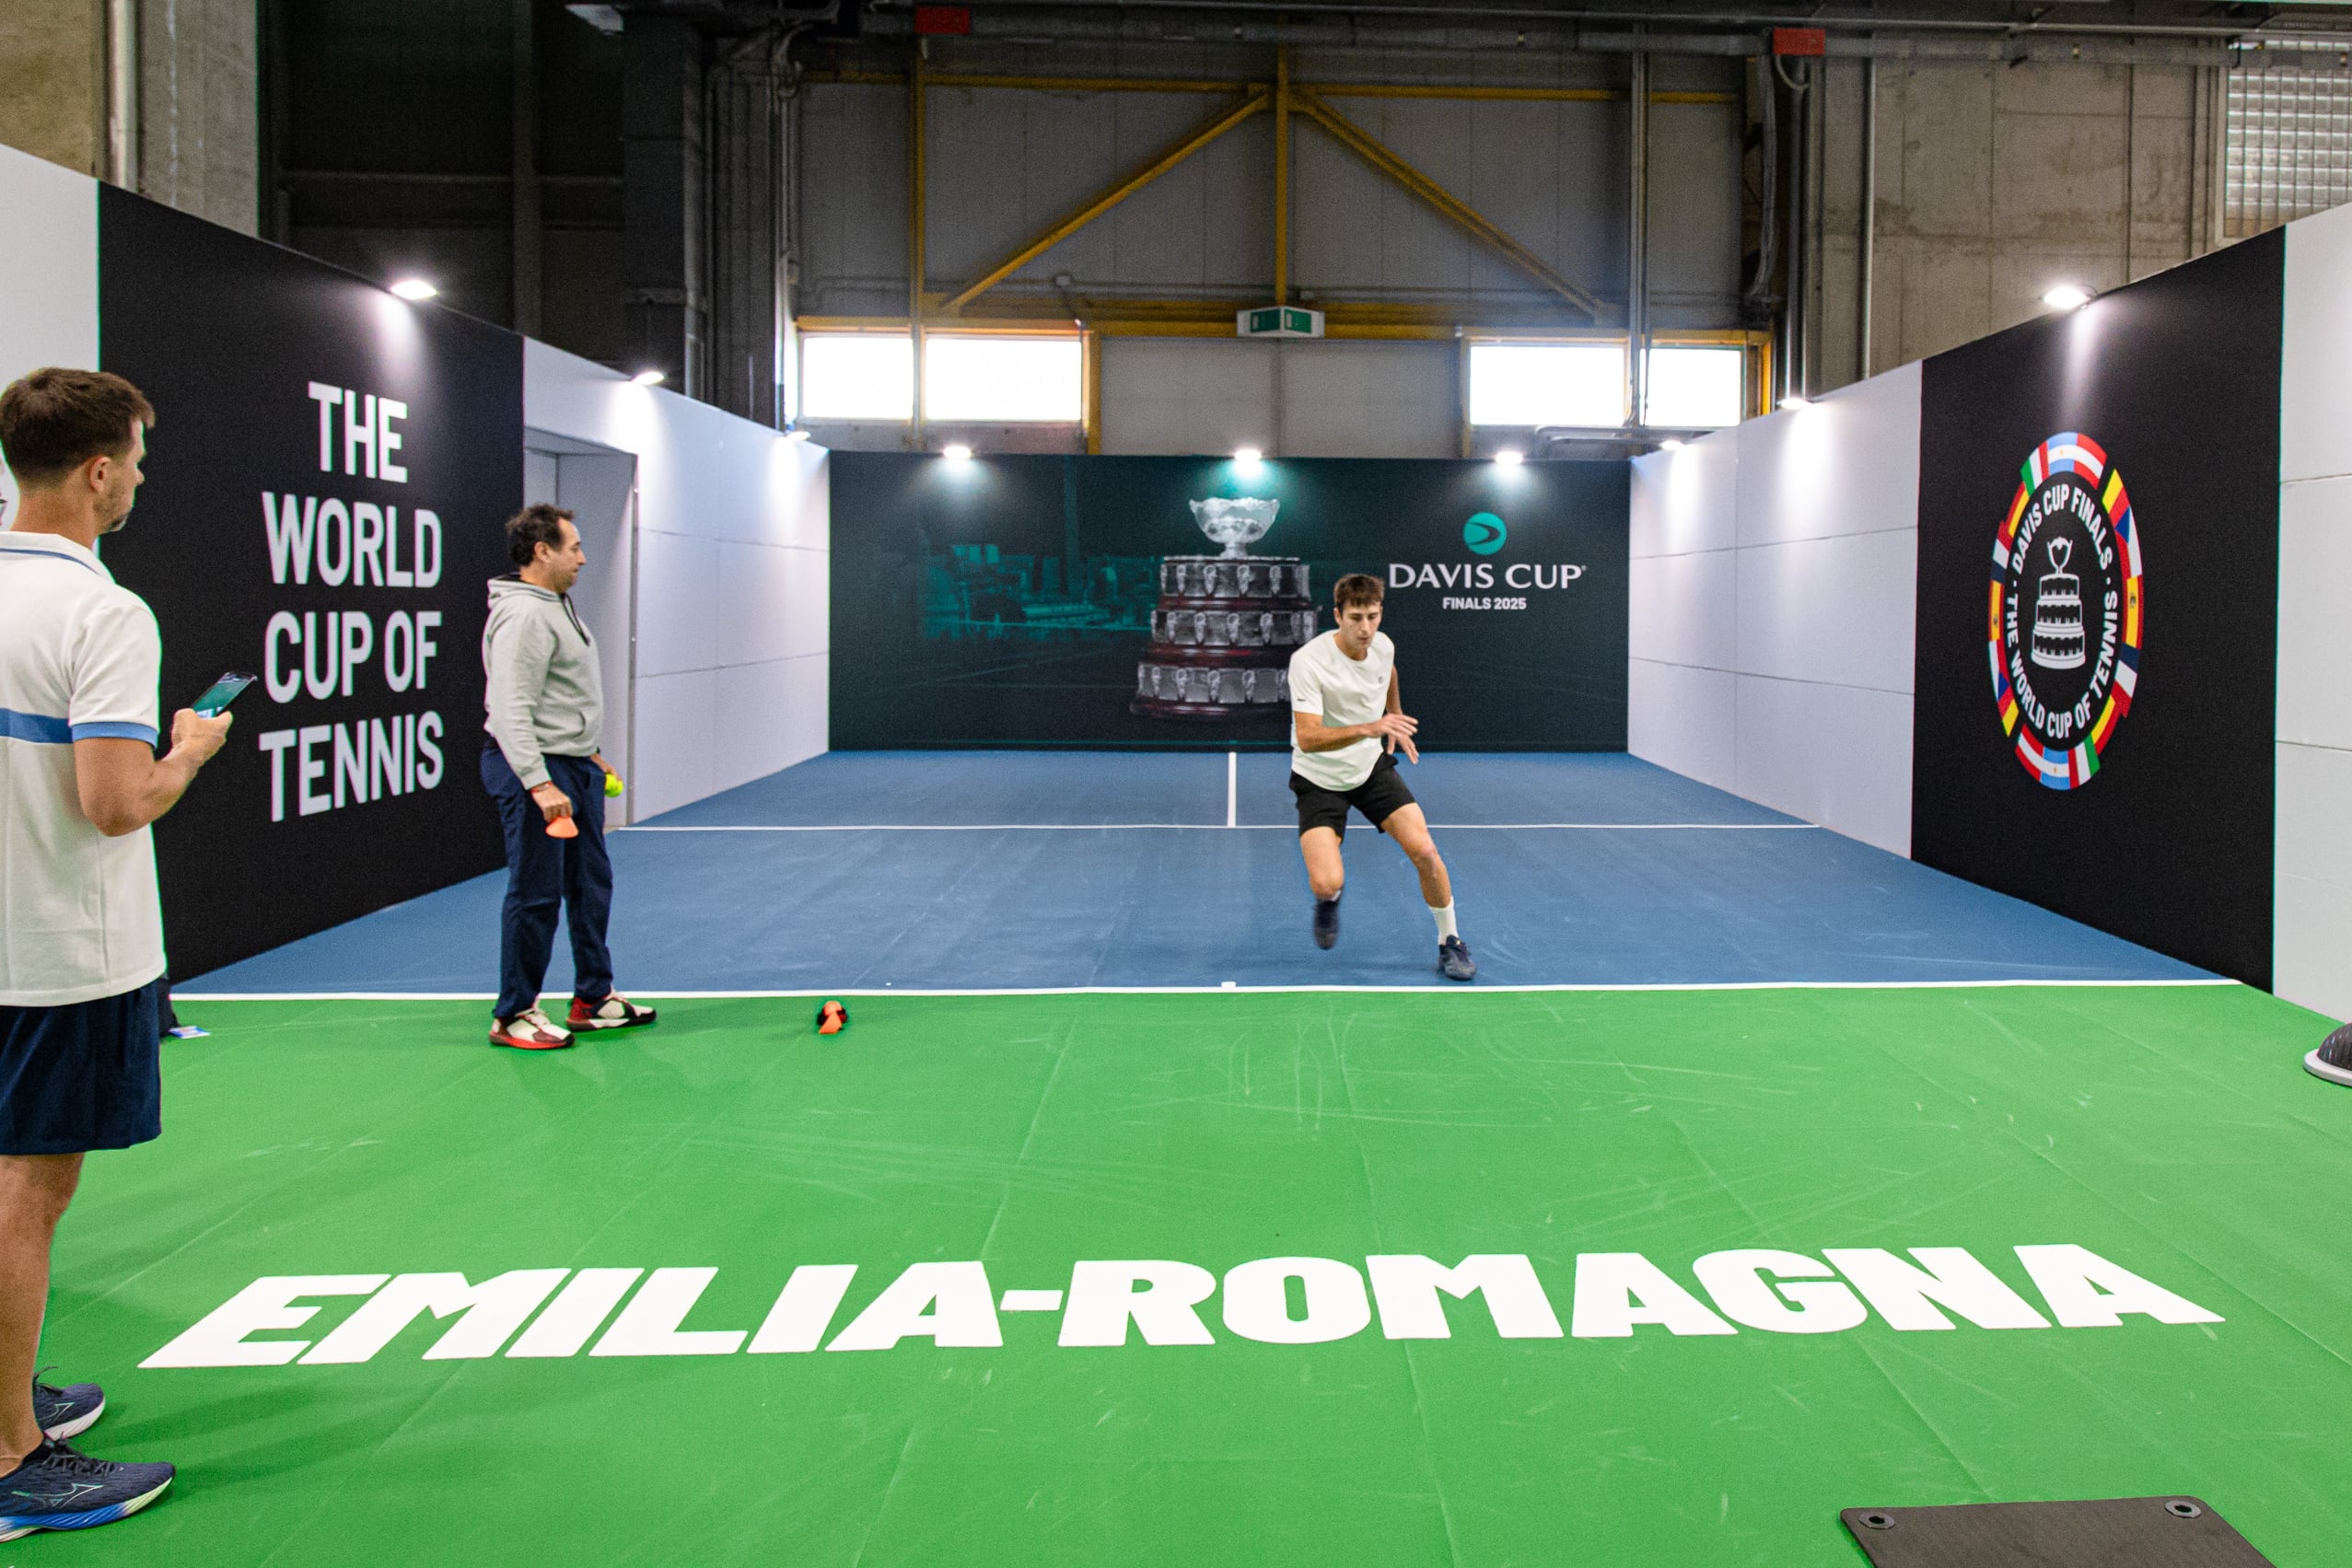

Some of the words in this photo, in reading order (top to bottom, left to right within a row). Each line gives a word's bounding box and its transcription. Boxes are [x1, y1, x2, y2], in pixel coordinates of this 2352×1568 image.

[307, 380, 408, 484] THE
[262, 491, 443, 588] WORLD
[2011, 502, 2043, 575] DAVIS
[2042, 482, 2070, 517] CUP
[2070, 486, 2113, 571] FINALS
[1388, 563, 1496, 589] DAVIS
[1442, 597, 1492, 610] FINALS
[1493, 597, 1528, 610] 2025
[2006, 593, 2020, 648] THE
[264, 610, 373, 703] CUP
[384, 610, 443, 693] OF
[2010, 648, 2046, 730] WORLD
[2089, 589, 2118, 700] TENNIS
[2045, 710, 2073, 739] CUP
[2074, 691, 2091, 729] OF
[259, 710, 444, 823] TENNIS
[137, 1243, 2226, 1369] EMILIA-ROMAGNA
